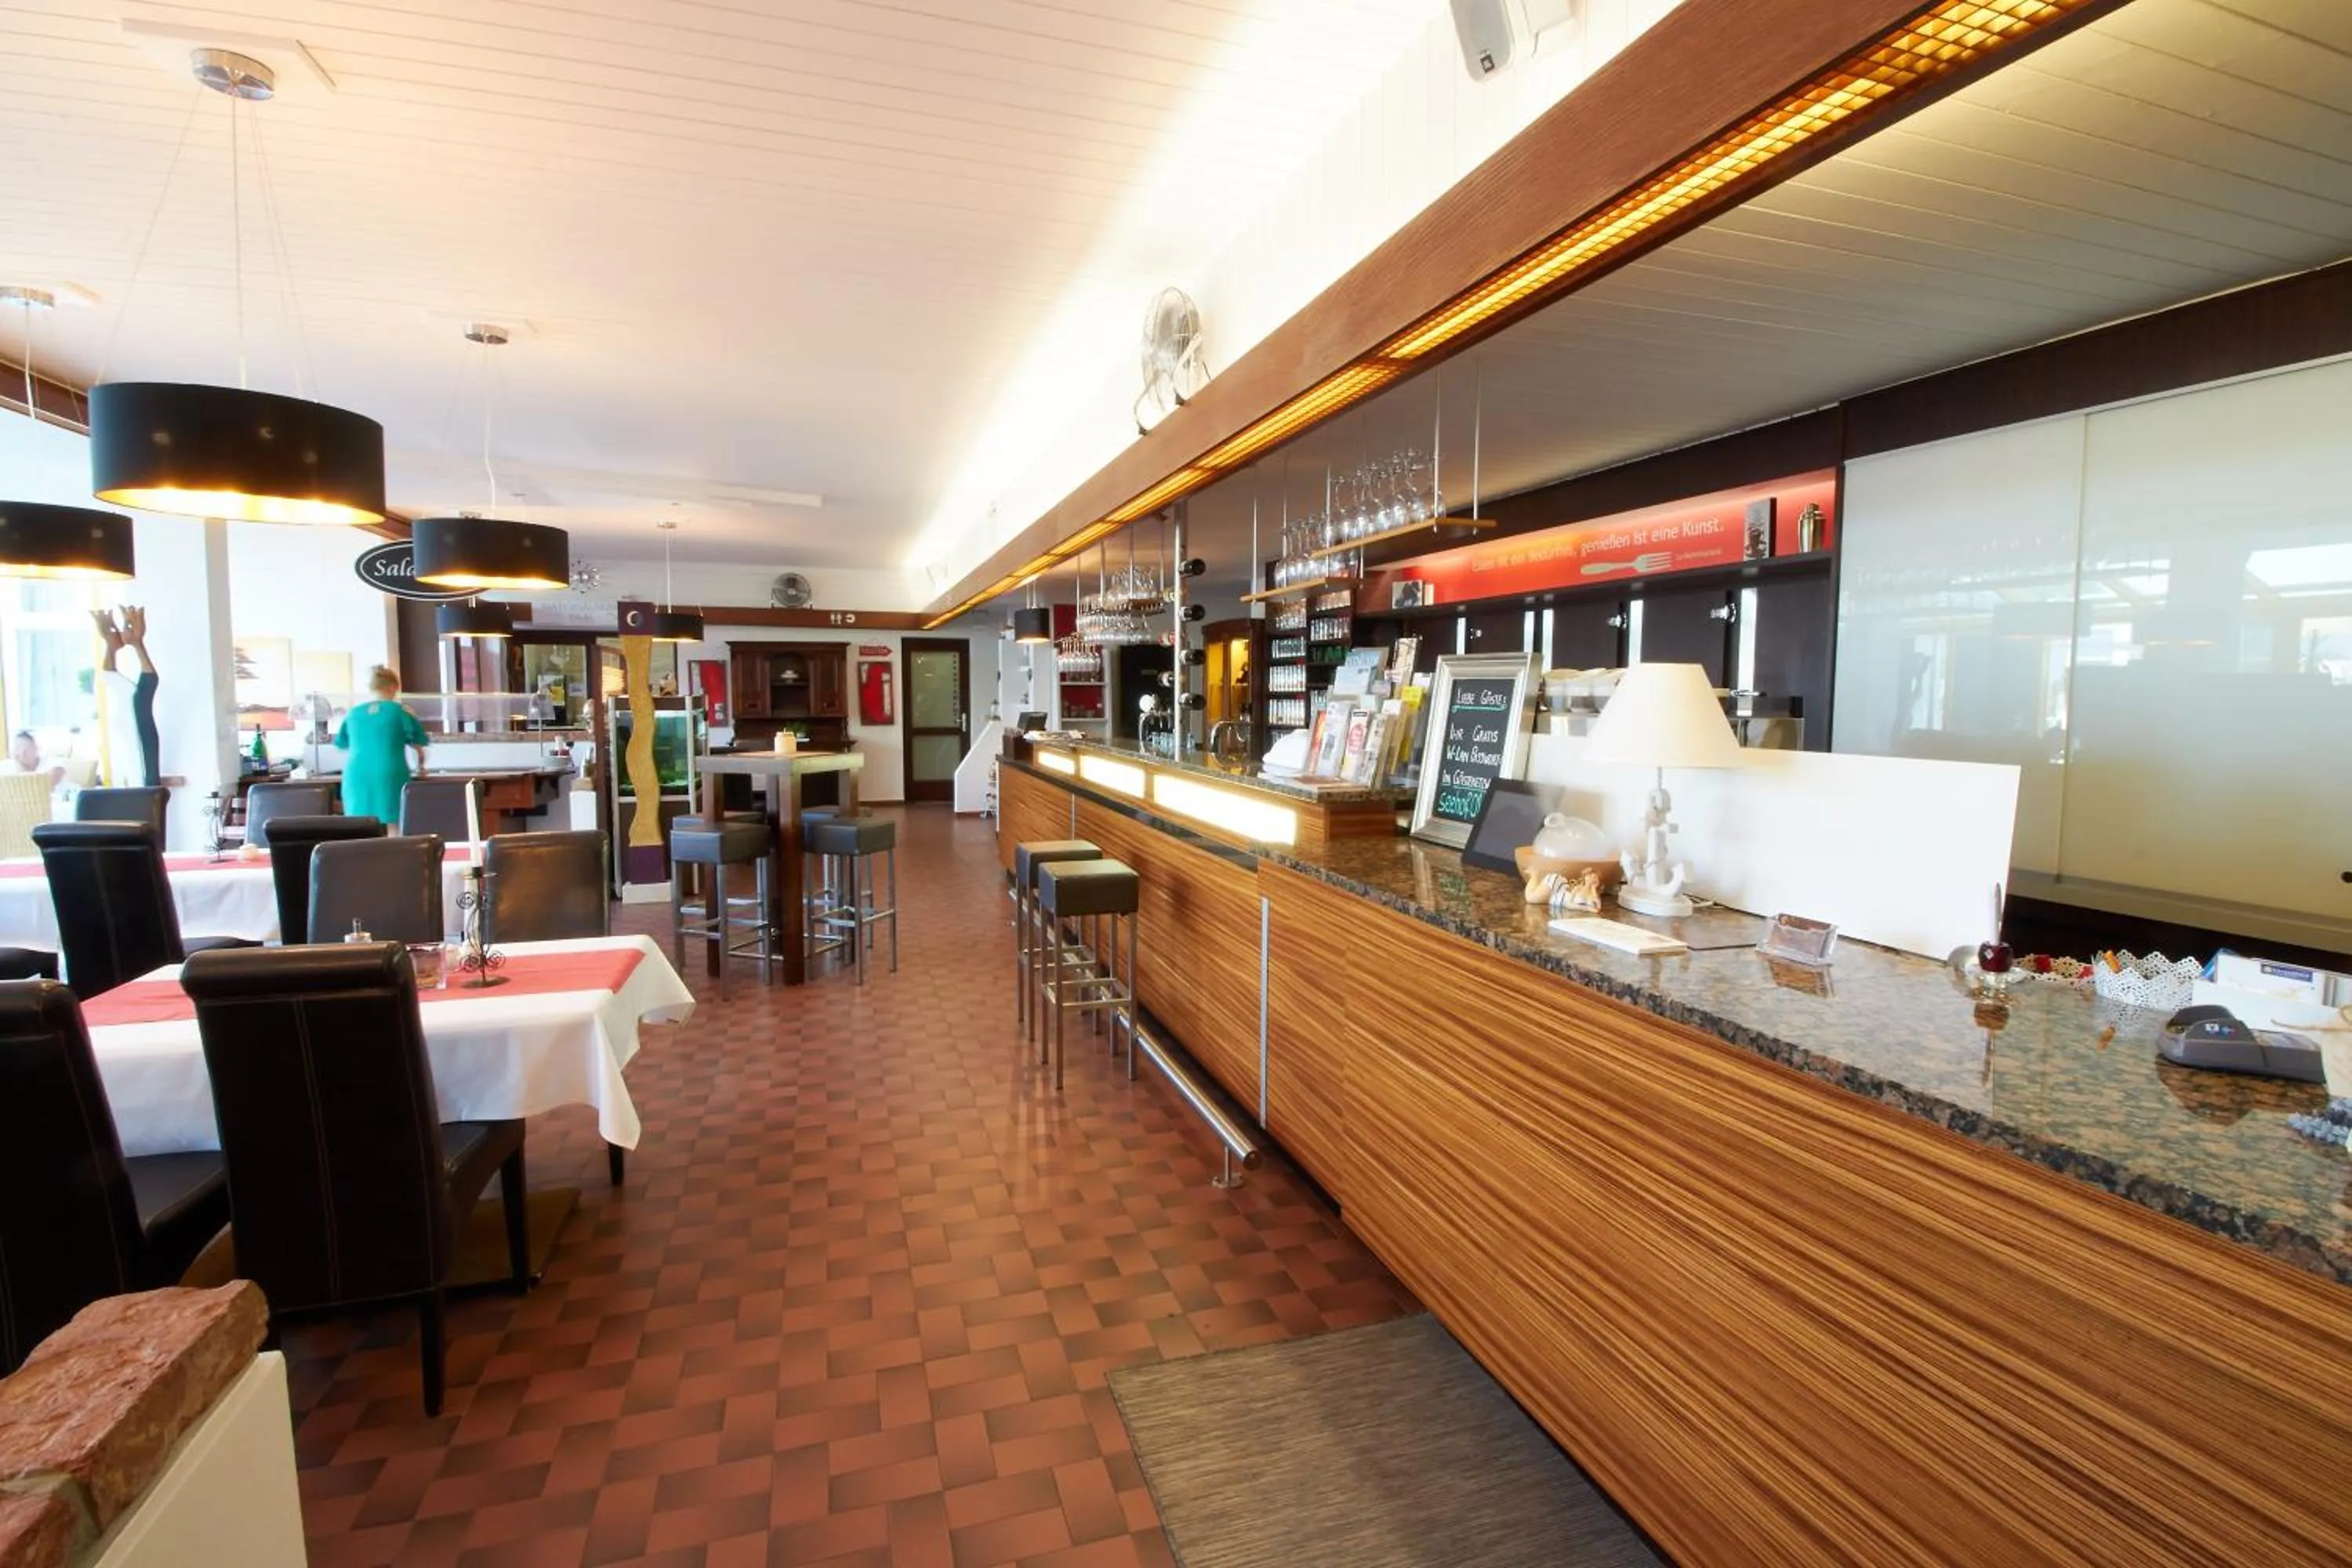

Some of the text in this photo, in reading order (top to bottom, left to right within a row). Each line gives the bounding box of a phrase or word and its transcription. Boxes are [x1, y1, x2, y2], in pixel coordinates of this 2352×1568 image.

[1633, 526, 1648, 546] ist
[1651, 526, 1679, 542] eine
[1682, 517, 1725, 537] Kunst.
